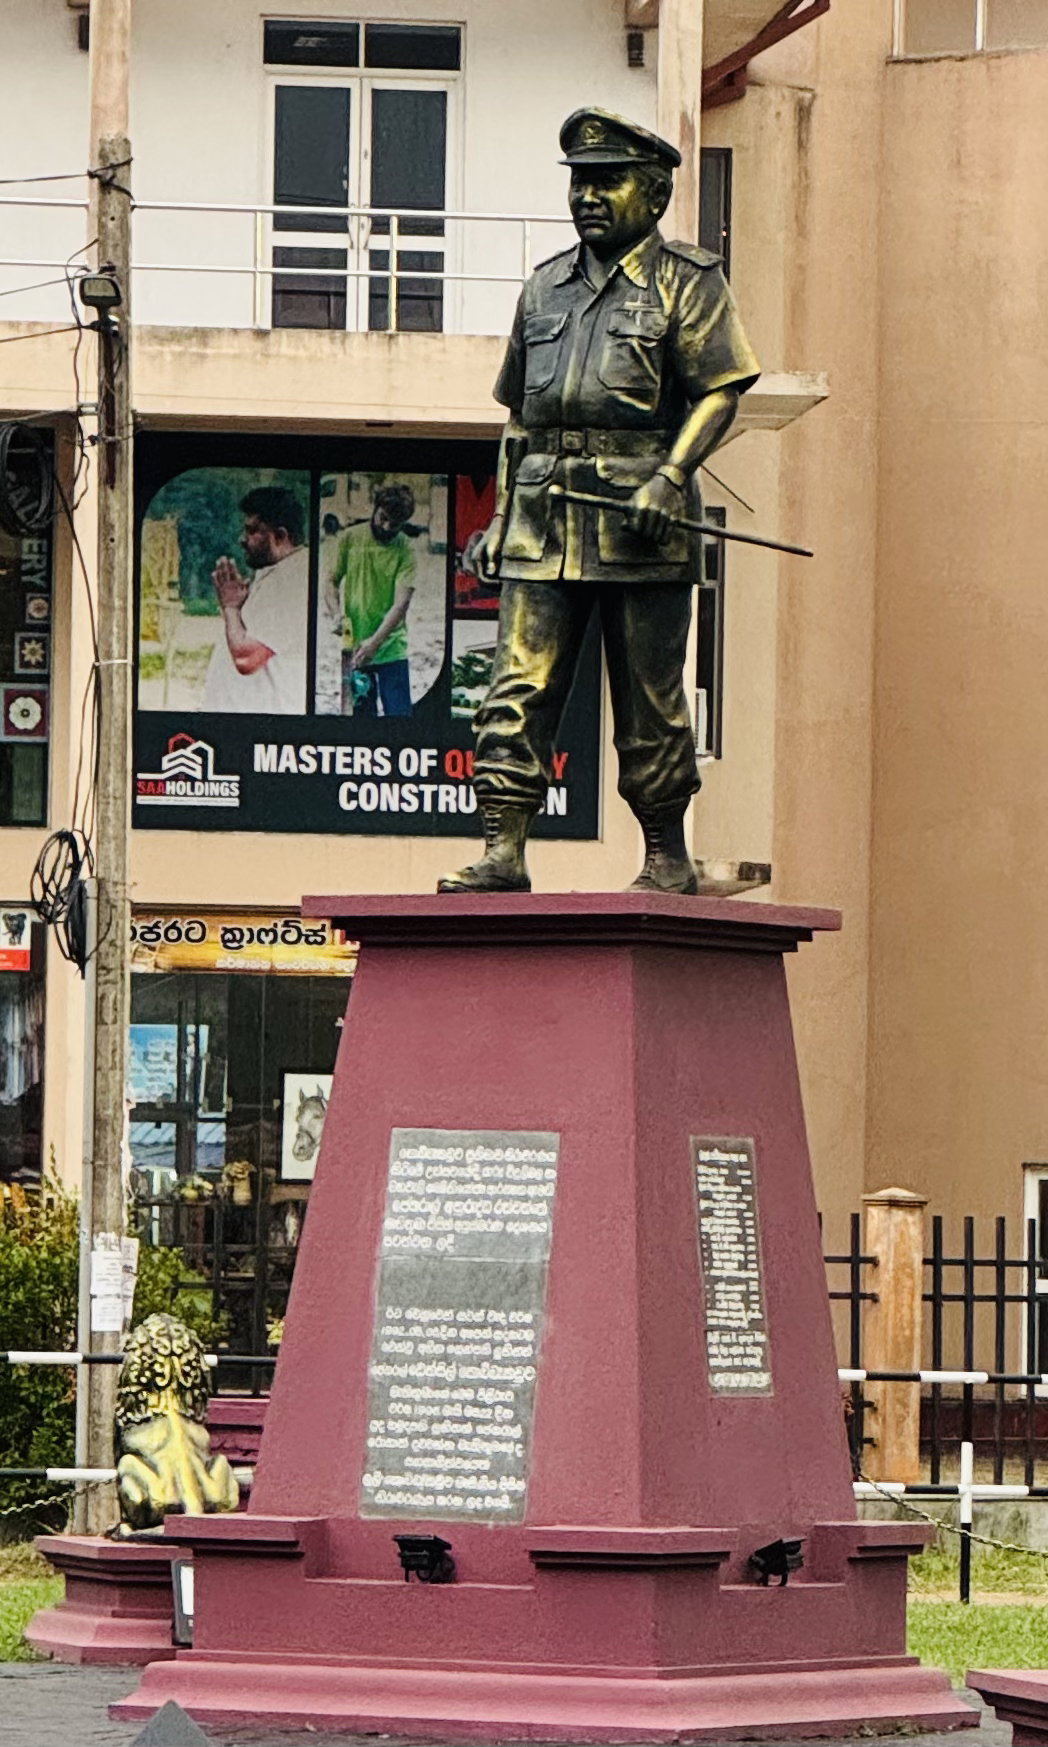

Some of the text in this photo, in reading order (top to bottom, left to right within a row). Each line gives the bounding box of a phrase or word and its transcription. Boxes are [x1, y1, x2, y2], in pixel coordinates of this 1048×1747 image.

[253, 743, 395, 776] MASTERS
[399, 748, 439, 777] OF
[338, 781, 568, 816] CONSTRUN
